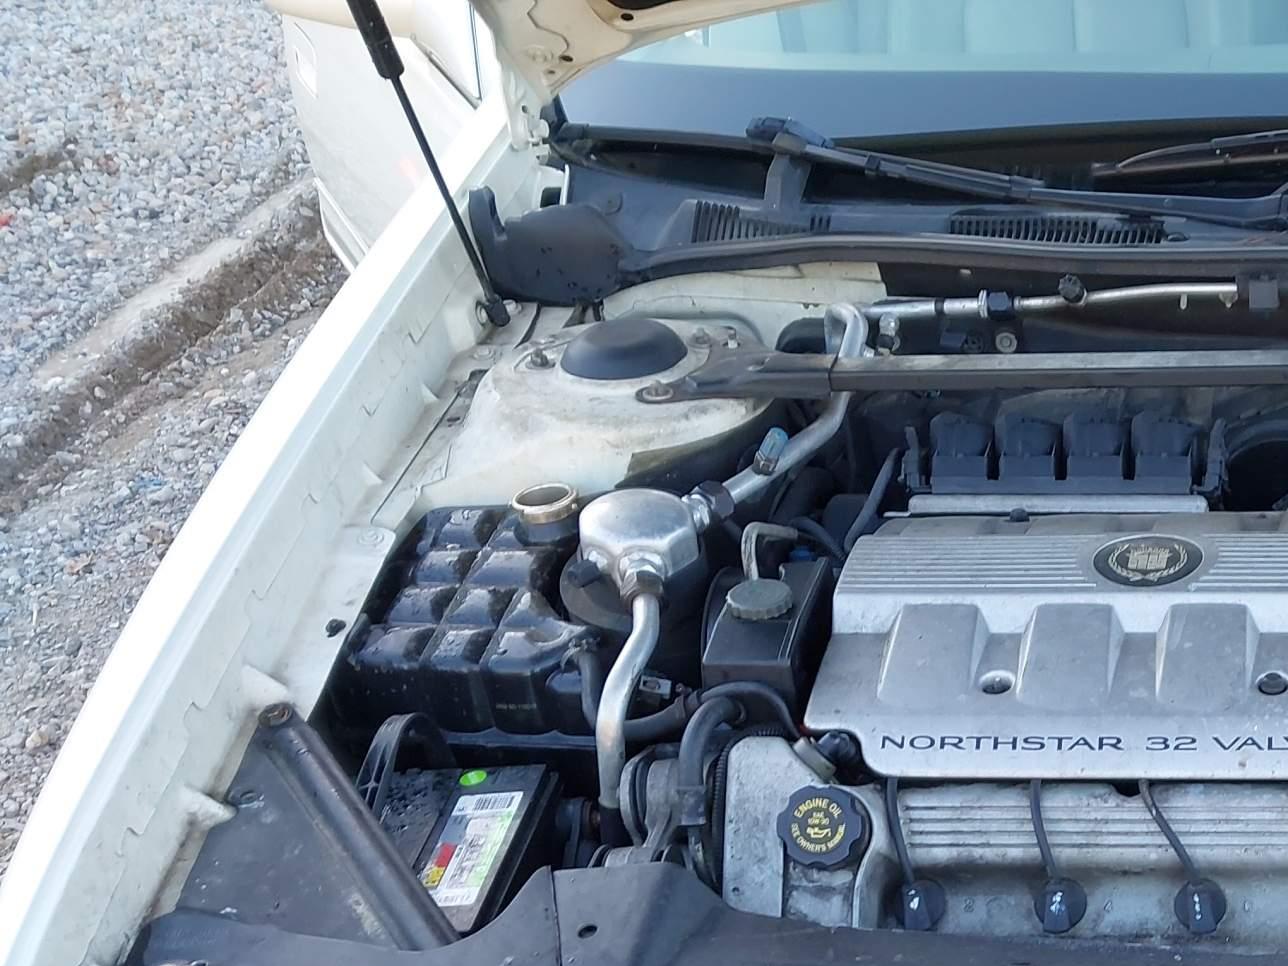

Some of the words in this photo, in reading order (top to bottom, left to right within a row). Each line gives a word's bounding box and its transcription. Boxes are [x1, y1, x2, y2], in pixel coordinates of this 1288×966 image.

[881, 735, 1124, 751] NORTHSTAR
[1145, 736, 1198, 751] 32
[794, 797, 829, 818] ENGINE
[829, 803, 842, 819] OIL
